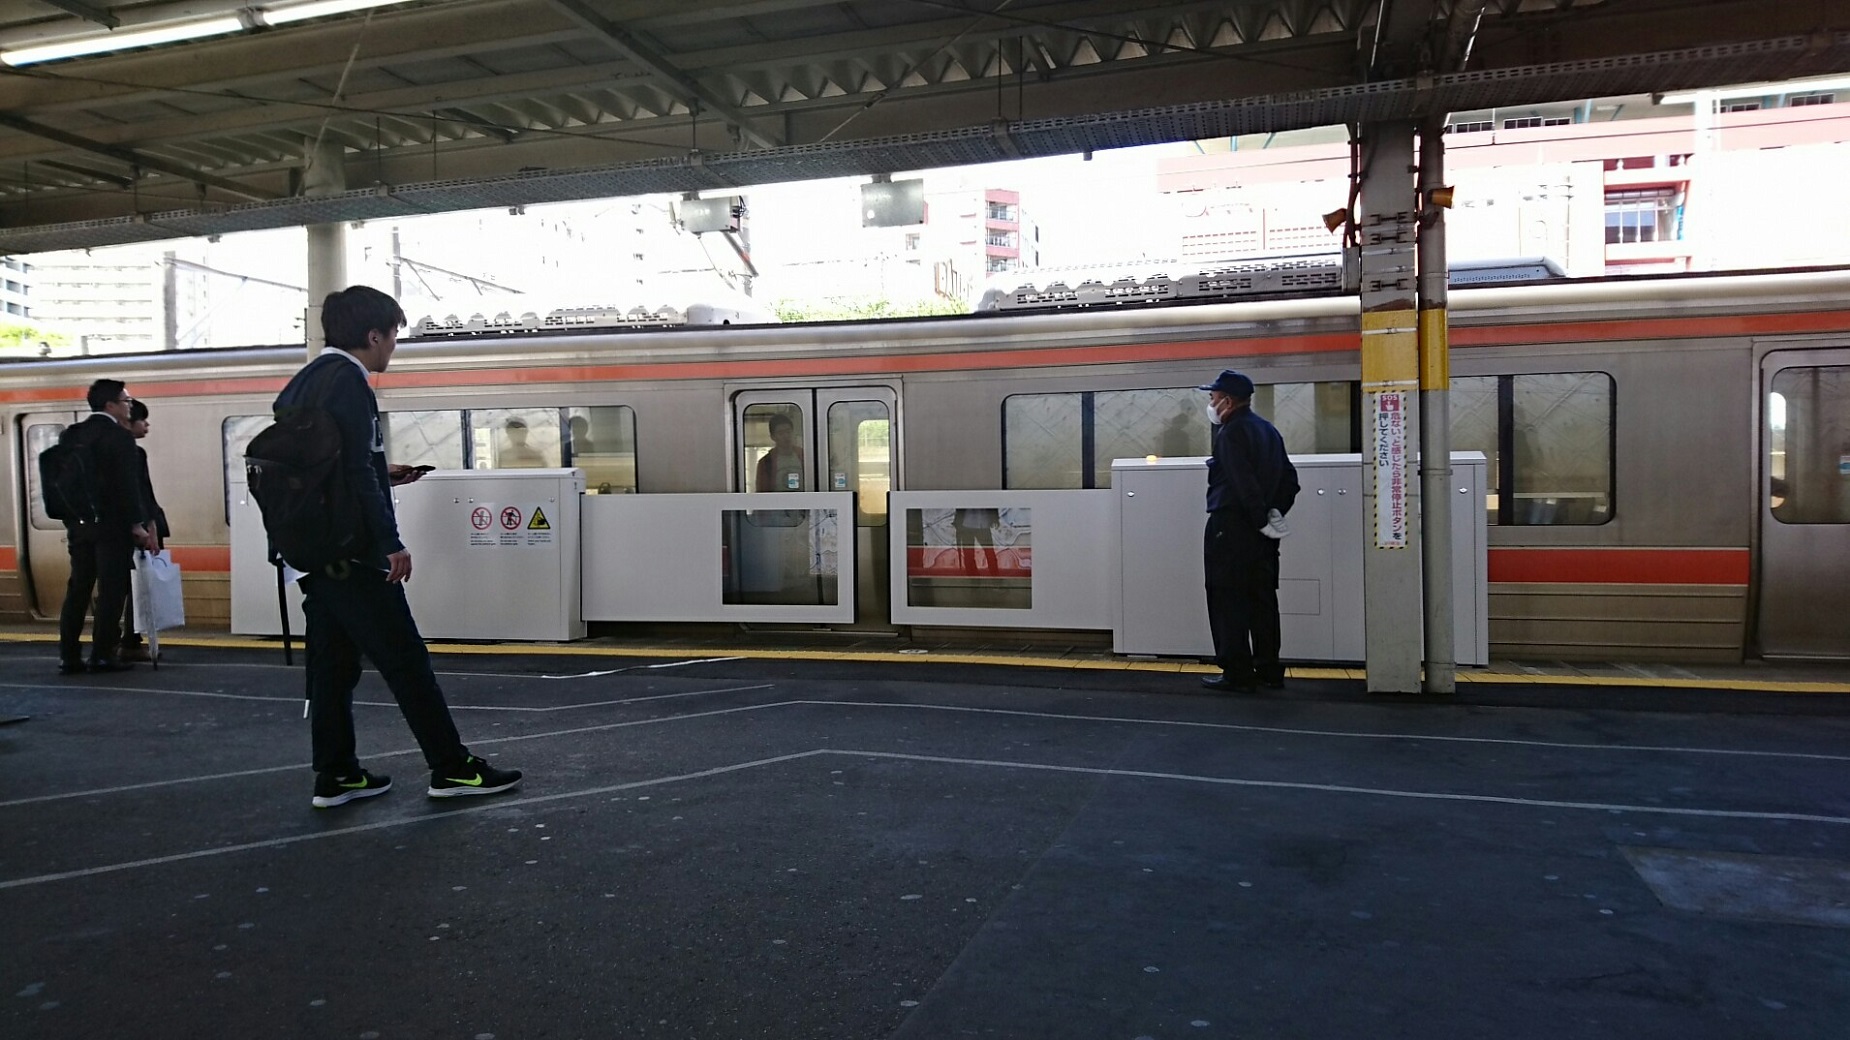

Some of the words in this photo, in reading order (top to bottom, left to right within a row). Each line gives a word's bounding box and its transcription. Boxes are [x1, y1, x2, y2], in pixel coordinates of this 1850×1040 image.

[1379, 412, 1389, 467] 押してください
